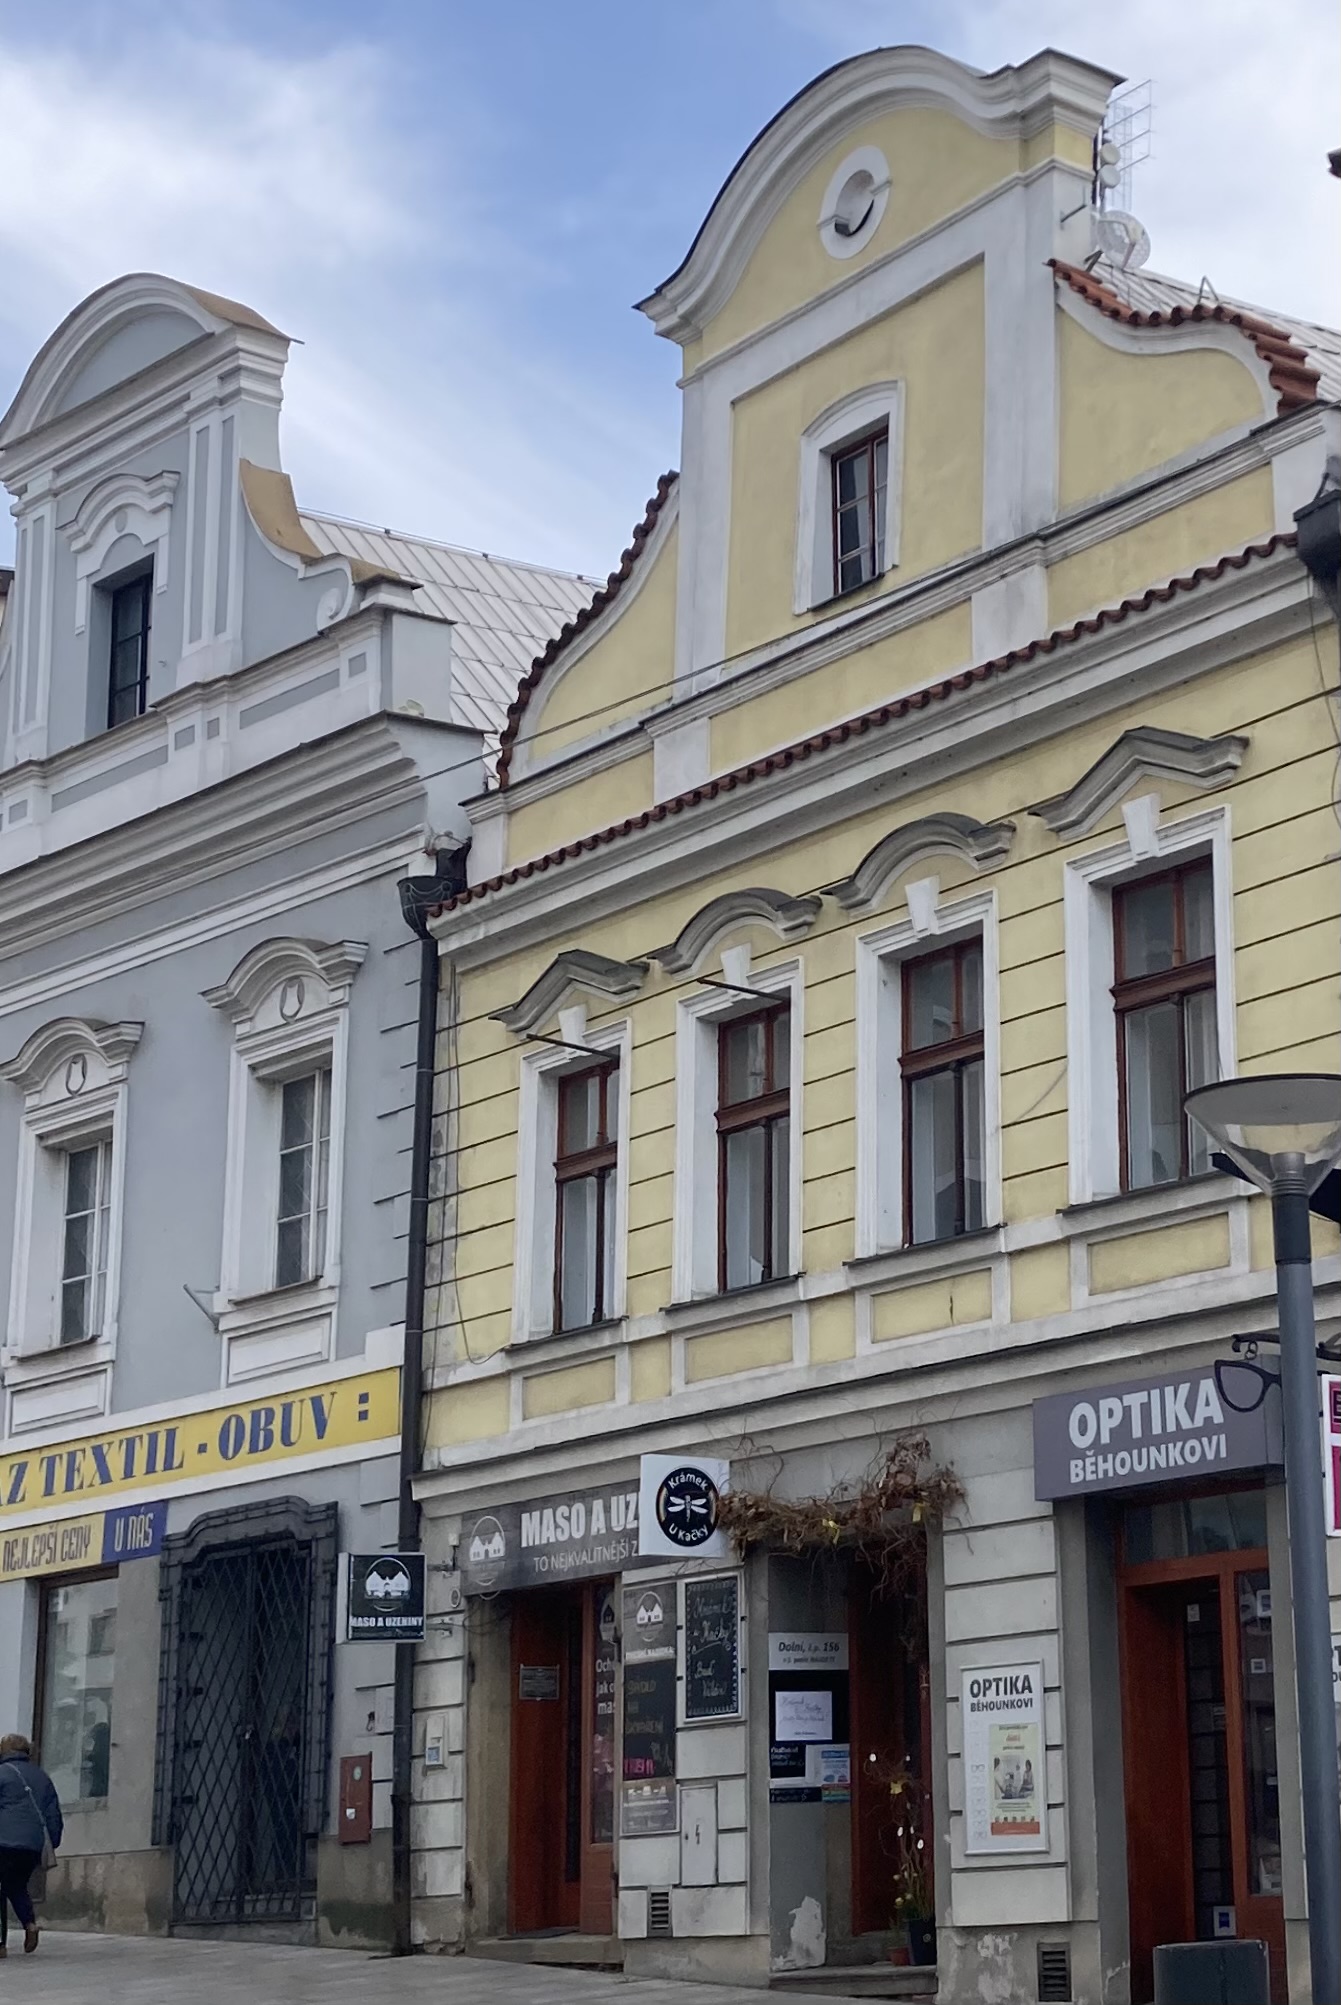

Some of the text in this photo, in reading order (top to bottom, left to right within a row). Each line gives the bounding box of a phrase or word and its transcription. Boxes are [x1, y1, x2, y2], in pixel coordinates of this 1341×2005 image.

[1068, 1377, 1224, 1449] OPTIKA
[0, 1461, 29, 1506] Z
[39, 1426, 184, 1498] TEXTIL
[218, 1392, 338, 1461] OBUV
[1069, 1433, 1228, 1484] BĚHOUNKOVI
[668, 1471, 709, 1491] Krámek
[114, 1507, 154, 1552] U NÁS
[520, 1502, 587, 1549] MASO
[590, 1498, 606, 1536] A
[668, 1523, 678, 1535] U
[3, 1522, 91, 1573] NEJLEPŠÍ CENY
[533, 1555, 548, 1573] TO
[350, 1616, 376, 1627] MASO
[377, 1616, 384, 1627] A
[970, 1674, 1033, 1699] OPTIKA
[970, 1698, 1034, 1713] BĚHOUNKOVI
